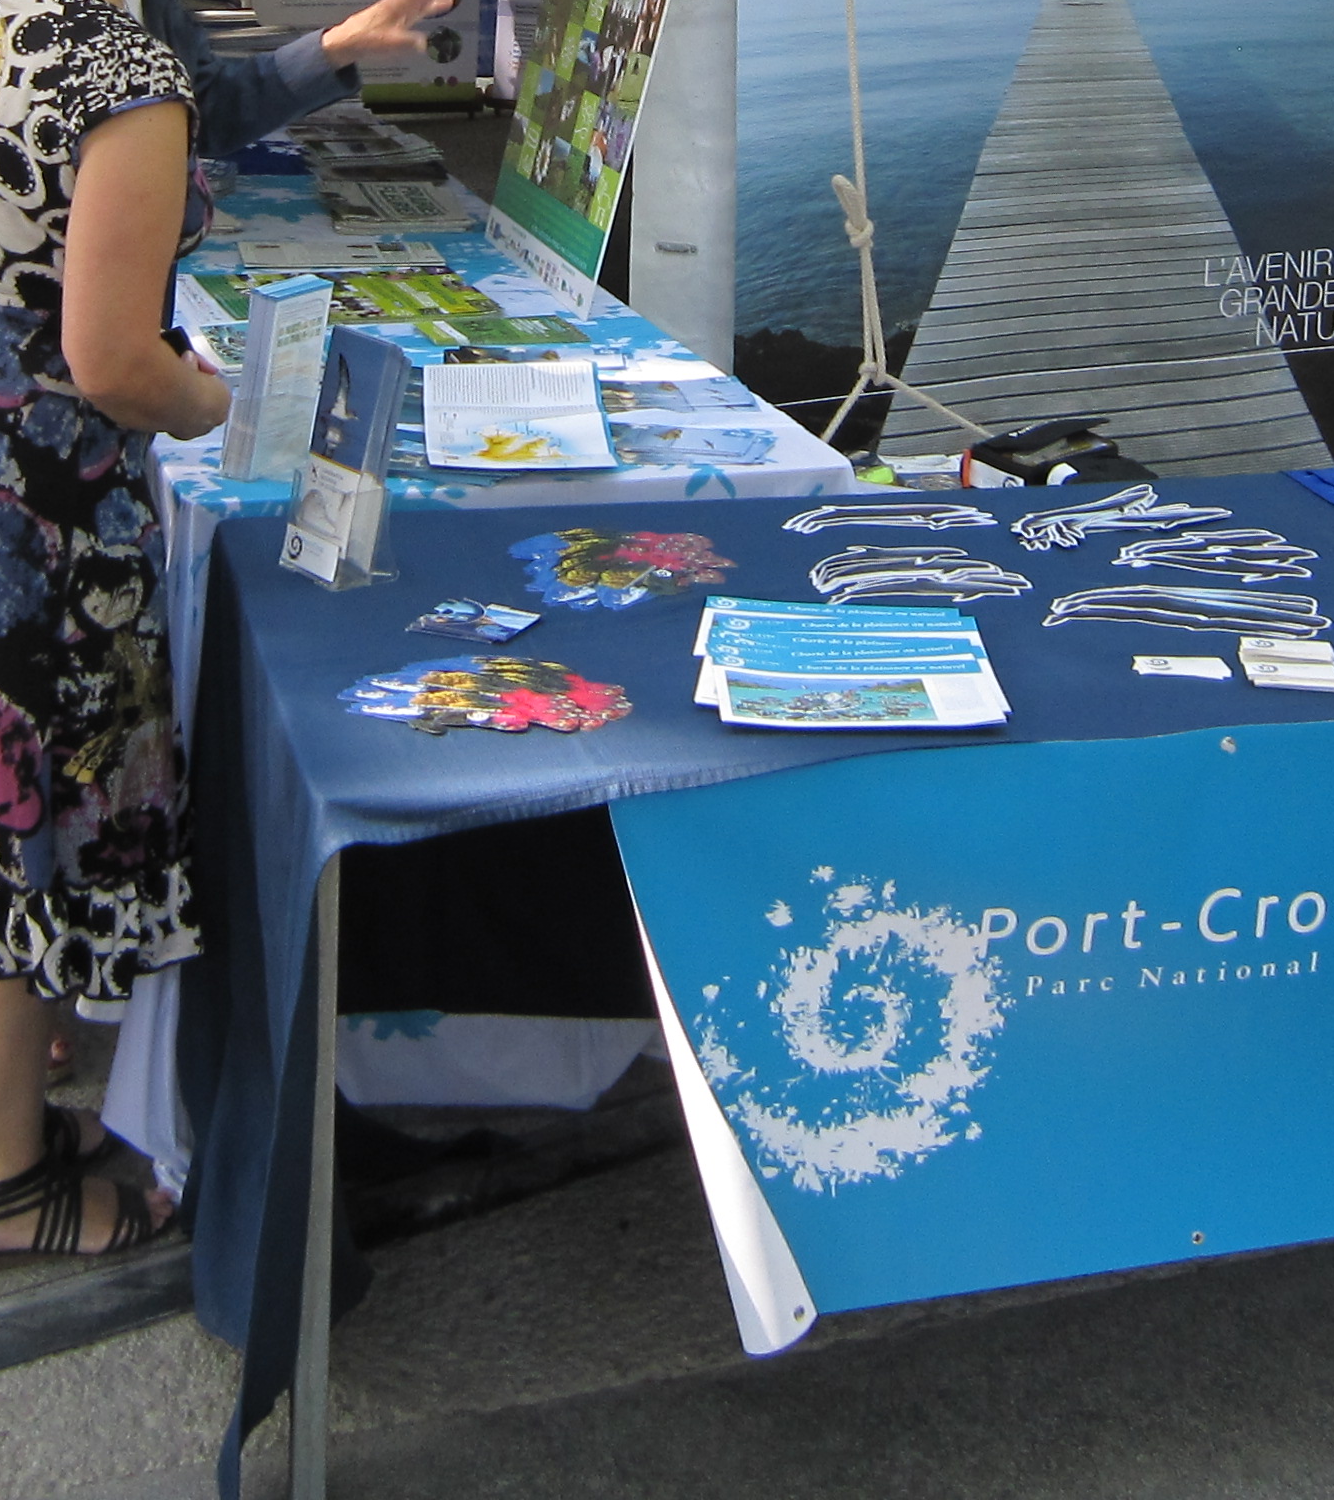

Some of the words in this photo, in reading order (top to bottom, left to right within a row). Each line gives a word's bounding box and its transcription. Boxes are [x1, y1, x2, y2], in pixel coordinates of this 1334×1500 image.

[1204, 247, 1334, 288] L'AVENIR
[1023, 967, 1116, 999] Parc
[1139, 953, 1323, 989] National
